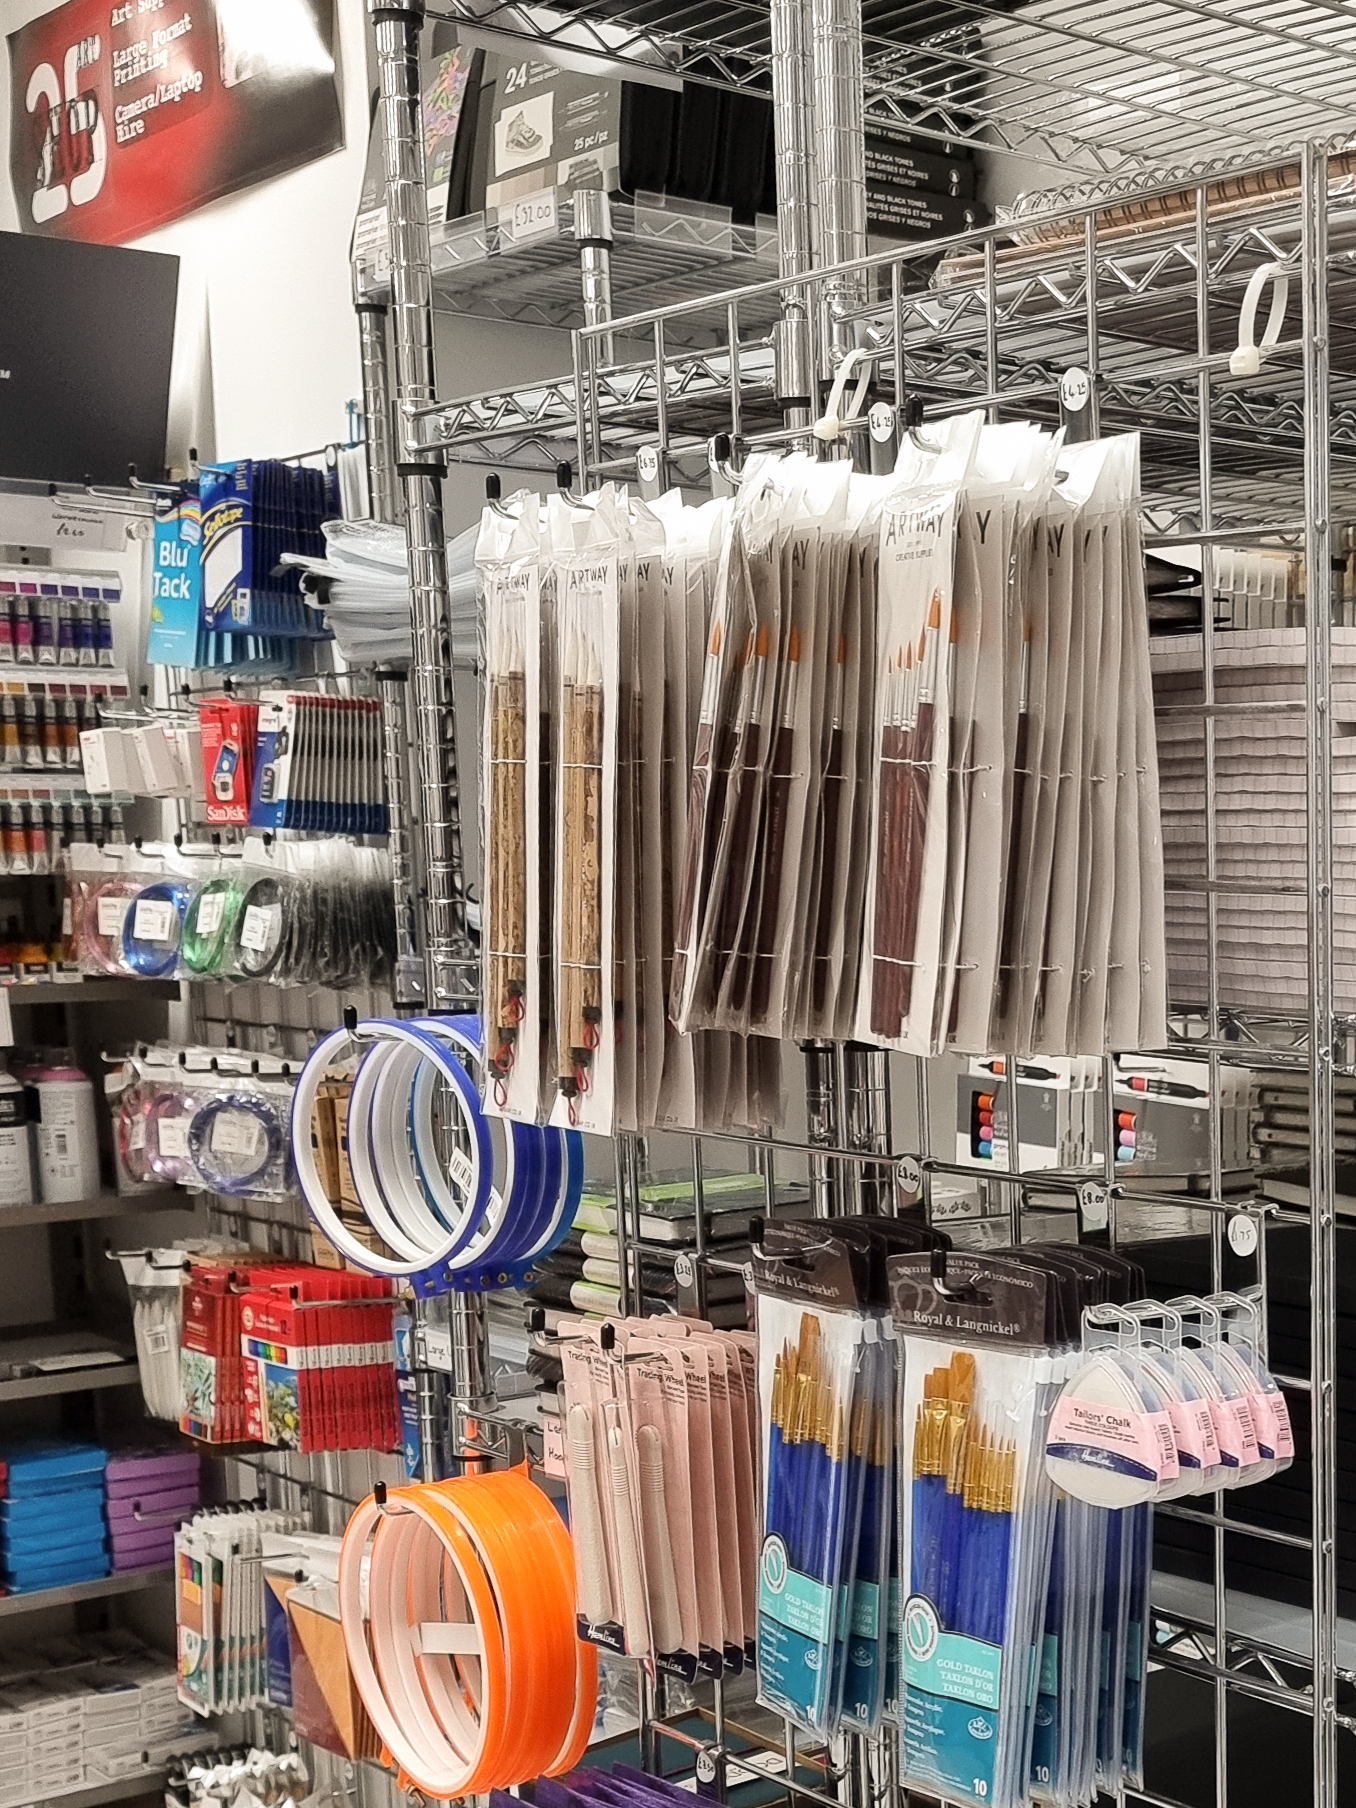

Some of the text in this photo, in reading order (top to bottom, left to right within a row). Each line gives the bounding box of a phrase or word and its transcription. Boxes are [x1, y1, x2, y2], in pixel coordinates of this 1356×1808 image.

[112, 41, 149, 69] Large
[152, 13, 193, 46] Format
[113, 49, 168, 87] Printing
[505, 61, 527, 95] 24
[115, 70, 204, 124] Camera/Laptop
[115, 120, 145, 144] Hire
[887, 195, 907, 205] BLACK
[515, 203, 551, 228] £32.00
[1063, 382, 1087, 401] £4.25
[886, 504, 943, 547] ARTWAY
[159, 541, 188, 567] Blu
[153, 572, 191, 599] Tack
[570, 565, 608, 590] ARTWAY
[207, 805, 248, 822] SanDisk
[1081, 1186, 1106, 1206] £8.00
[764, 1270, 785, 1285] Royal
[785, 1276, 792, 1287] &
[913, 1310, 943, 1326] Royal
[944, 1316, 954, 1327] &
[567, 1350, 591, 1365] Tracing
[637, 1367, 663, 1383] Tracing
[1074, 1407, 1132, 1429] Tailors' Chalk
[936, 1658, 994, 1680] GOLD TAKLON
[940, 1670, 994, 1692] TAKLON D'OR
[942, 1683, 993, 1704] TAKLON ORO
[854, 1702, 868, 1719] 10
[1035, 1765, 1049, 1783] 10
[973, 1777, 988, 1797] 10
